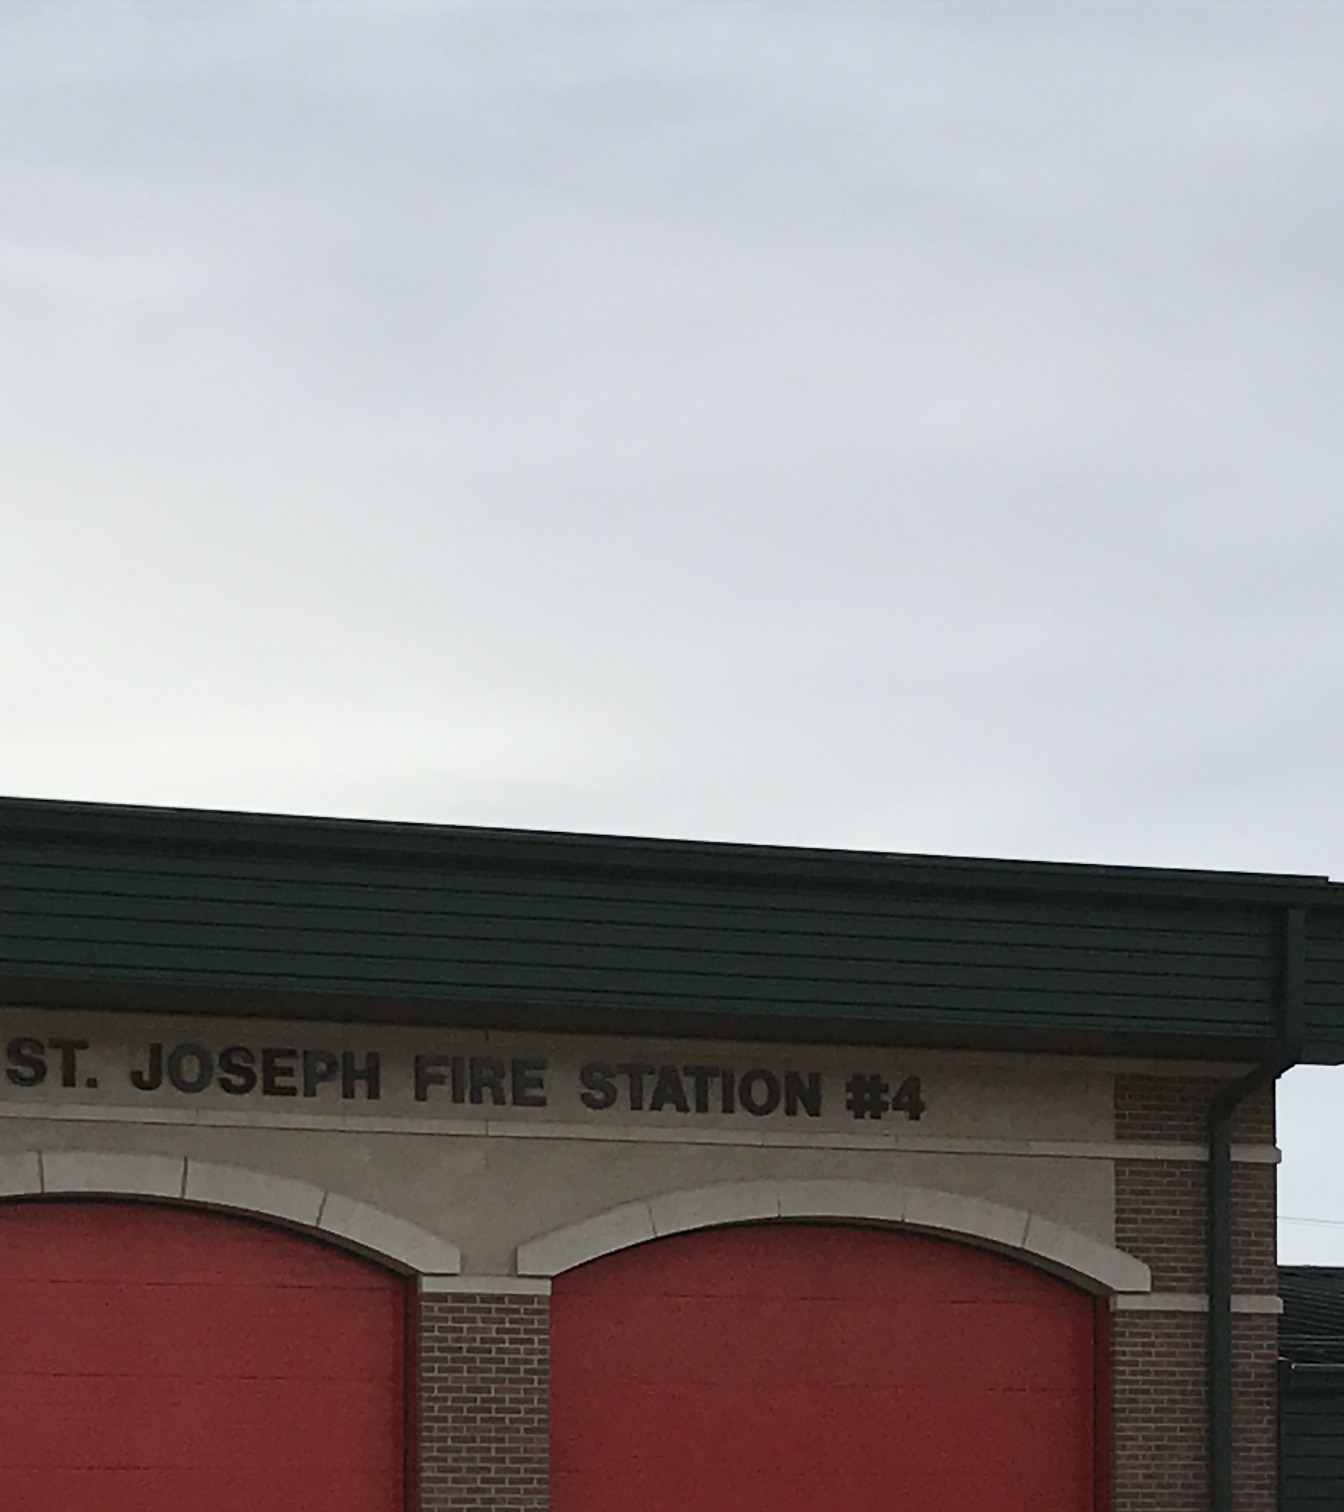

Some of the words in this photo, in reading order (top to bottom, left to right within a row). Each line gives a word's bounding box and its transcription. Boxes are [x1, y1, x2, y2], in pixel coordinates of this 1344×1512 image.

[6, 1036, 98, 1088] ST.
[130, 1042, 380, 1100] JOSEPH
[414, 1054, 548, 1108] FIRE
[579, 1062, 823, 1118] STATION
[845, 1072, 926, 1121] #4
